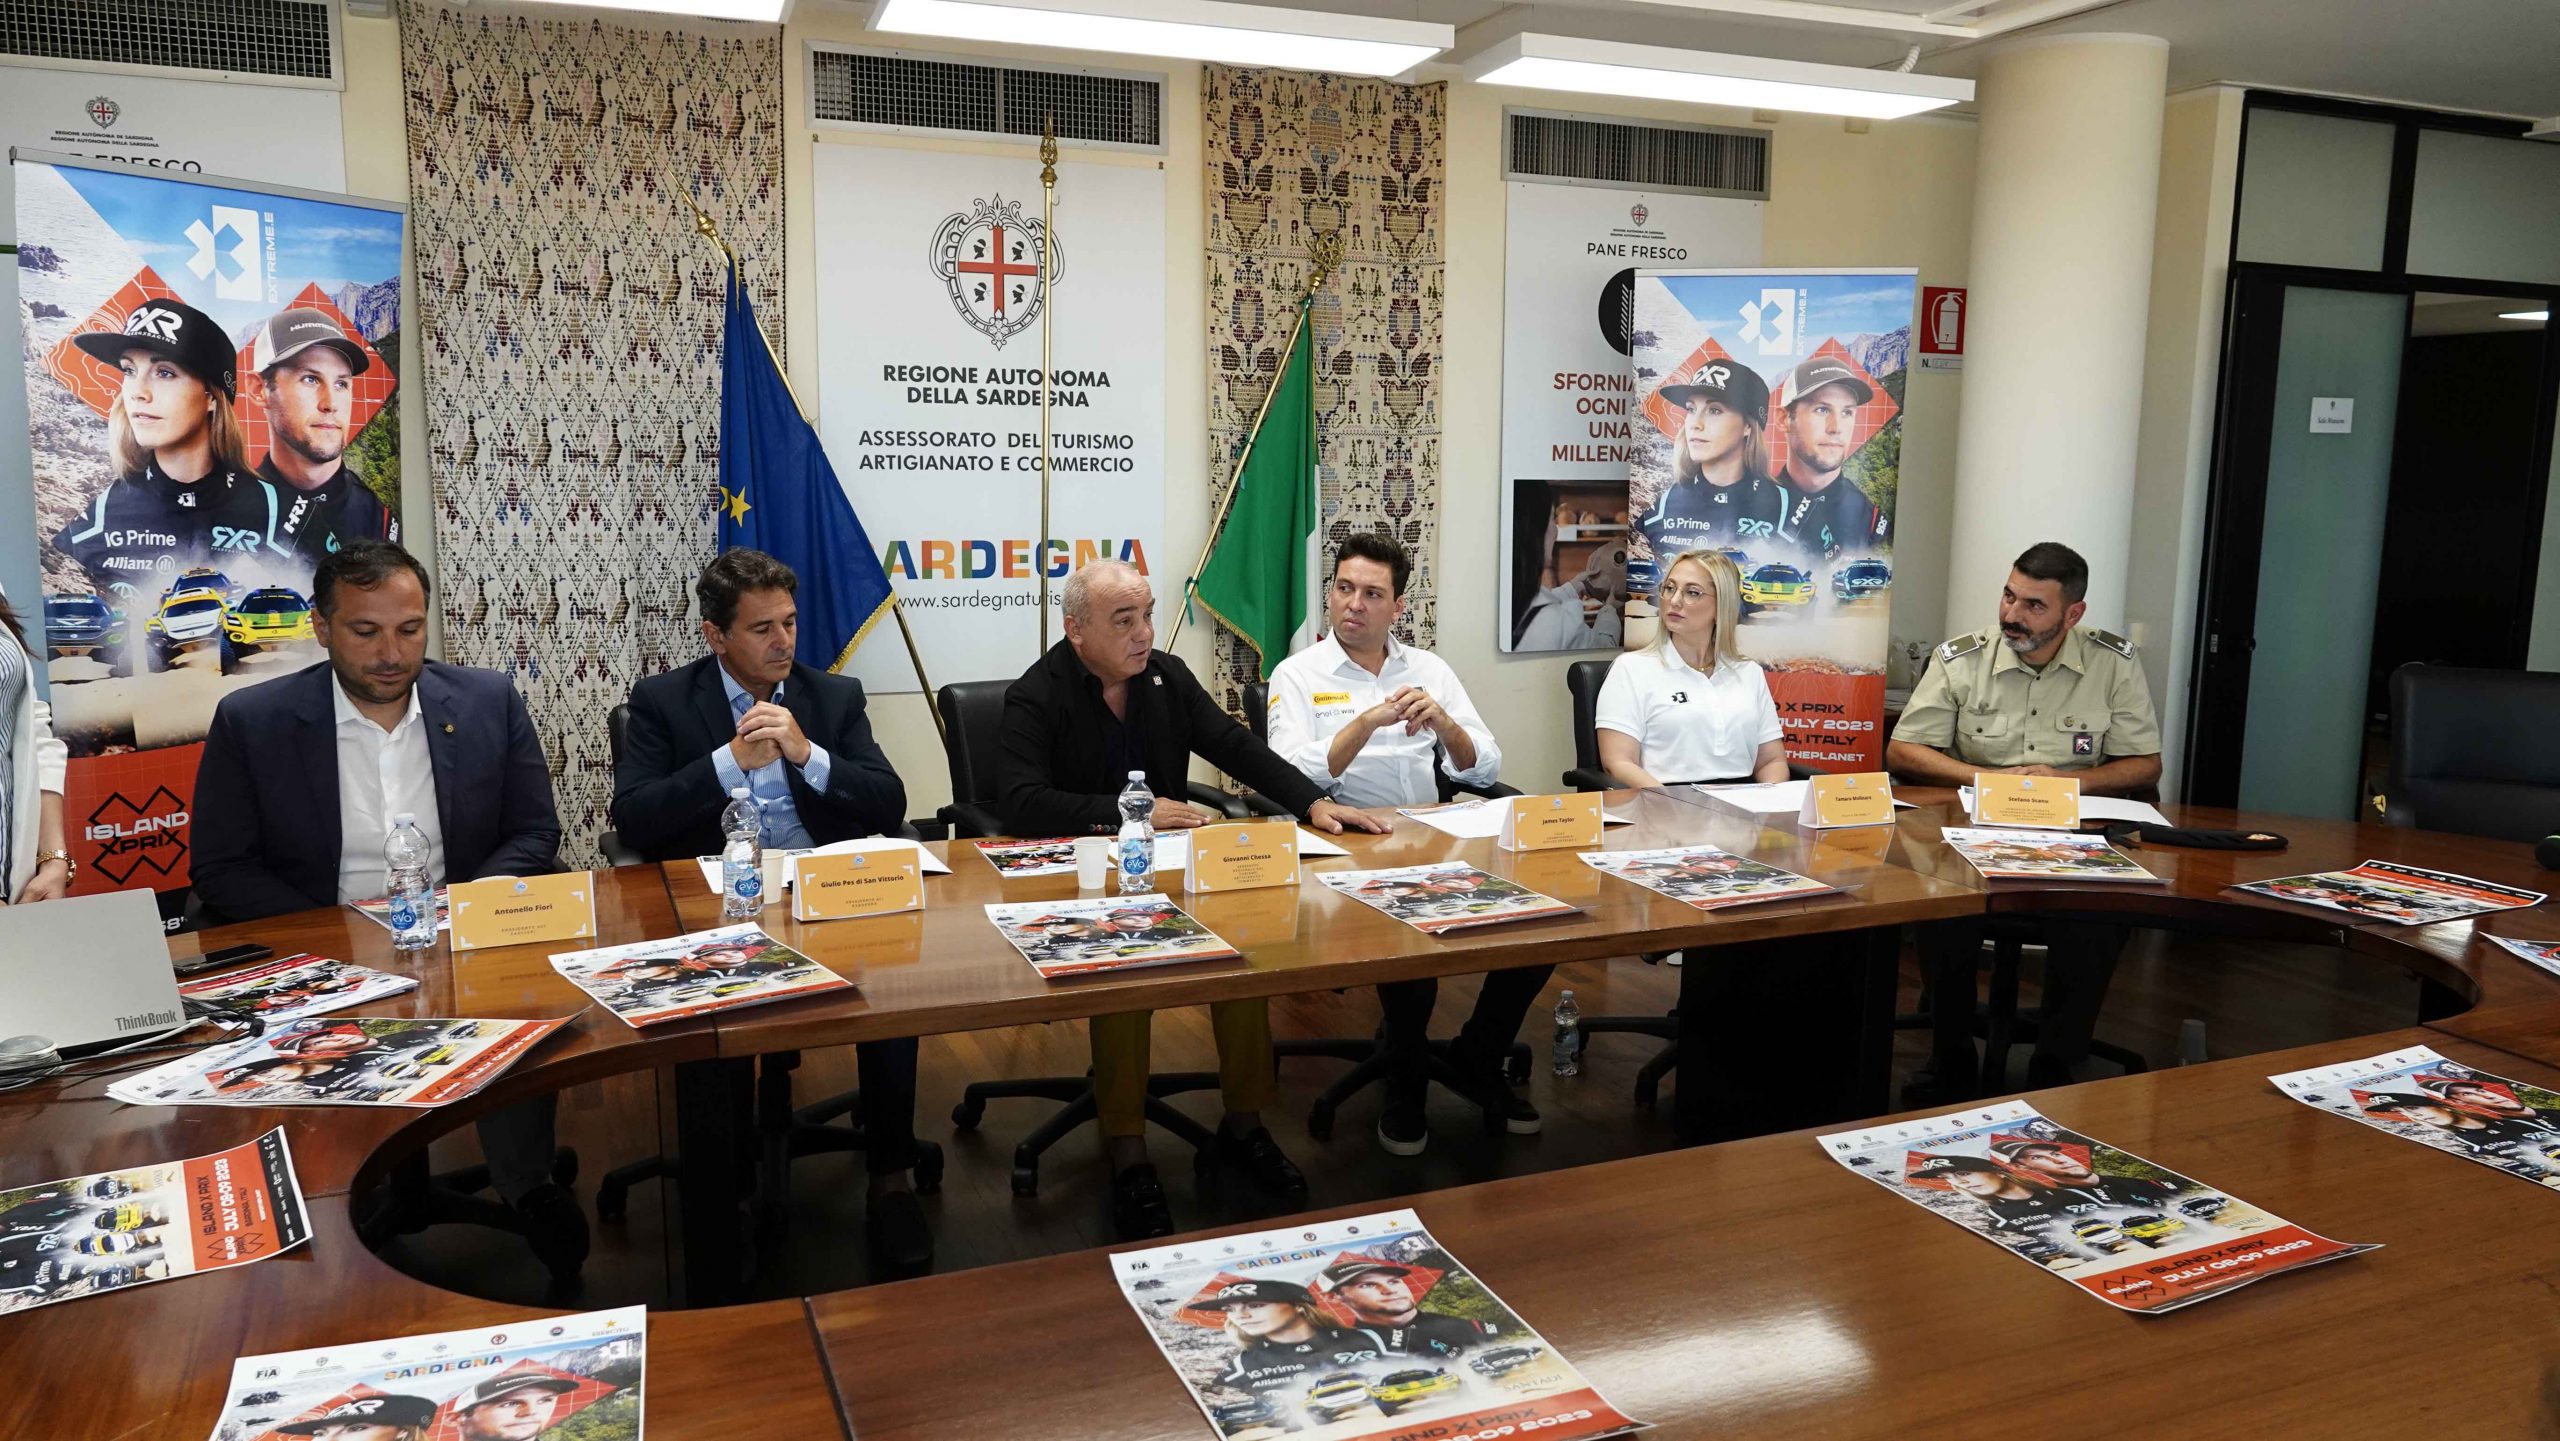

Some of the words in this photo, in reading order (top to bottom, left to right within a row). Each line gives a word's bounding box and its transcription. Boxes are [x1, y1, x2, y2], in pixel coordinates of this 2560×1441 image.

[1586, 241, 1627, 258] PANE
[1631, 244, 1688, 261] FRESCO
[883, 364, 979, 384] REGIONE
[985, 367, 1111, 388] AUTONOMA
[907, 386, 969, 405] DELLA
[1576, 397, 1626, 415] OGNI
[1589, 421, 1632, 439] UNA
[858, 430, 996, 448] ASSESSORATO
[1007, 432, 1042, 448] DEL
[1051, 433, 1134, 450] TURISMO
[859, 454, 994, 471] ARTIGIANATO
[1000, 456, 1010, 471] E
[1017, 456, 1134, 472] COMMERCIO
[1663, 518, 1675, 530] IG
[1676, 517, 1711, 531] Prime
[104, 530, 124, 548] IG
[126, 529, 177, 547] Prime
[1659, 535, 1693, 547] Allianz
[102, 556, 154, 571] Allianz
[874, 538, 1150, 580] ARDEGNA
[897, 589, 1062, 611] www.sardegnatuis
[1784, 702, 1798, 712] X
[1801, 703, 1845, 715] PRIX
[1778, 717, 1820, 729] JULY
[1823, 719, 1874, 731] 2023
[1806, 734, 1857, 746] ITALY
[85, 811, 190, 841] ISLAND
[98, 829, 180, 855] XPRIX
[1125, 858, 1146, 870] eva
[1222, 854, 1250, 863] Giovanni
[1250, 853, 1272, 861] Chessa
[738, 879, 760, 892] eva
[820, 879, 842, 888] Giulio
[842, 879, 855, 887] Pes
[391, 912, 414, 925] eva
[494, 906, 534, 916] Antonello
[534, 903, 553, 912] Fiori
[114, 1008, 178, 1032] ThinkBook
[221, 1206, 240, 1232] JULY
[2020, 1212, 2052, 1224] Prime
[1131, 1261, 1149, 1271] FIA
[1235, 1248, 1328, 1271] SARDEGNA
[2146, 1254, 2213, 1276] ISLAND
[2213, 1249, 2229, 1259] X
[2161, 1265, 2209, 1283] JULY
[2262, 1239, 2313, 1256] 2023
[256, 1368, 278, 1380] FIA
[383, 1355, 504, 1382] SARDEGNA
[1262, 1363, 1306, 1377] Prime
[1251, 1376, 1291, 1389] Allianz
[1437, 1425, 1515, 1441] 8-09
[1519, 1408, 1594, 1432] 2023
[1476, 1407, 1540, 1427] PRIX
